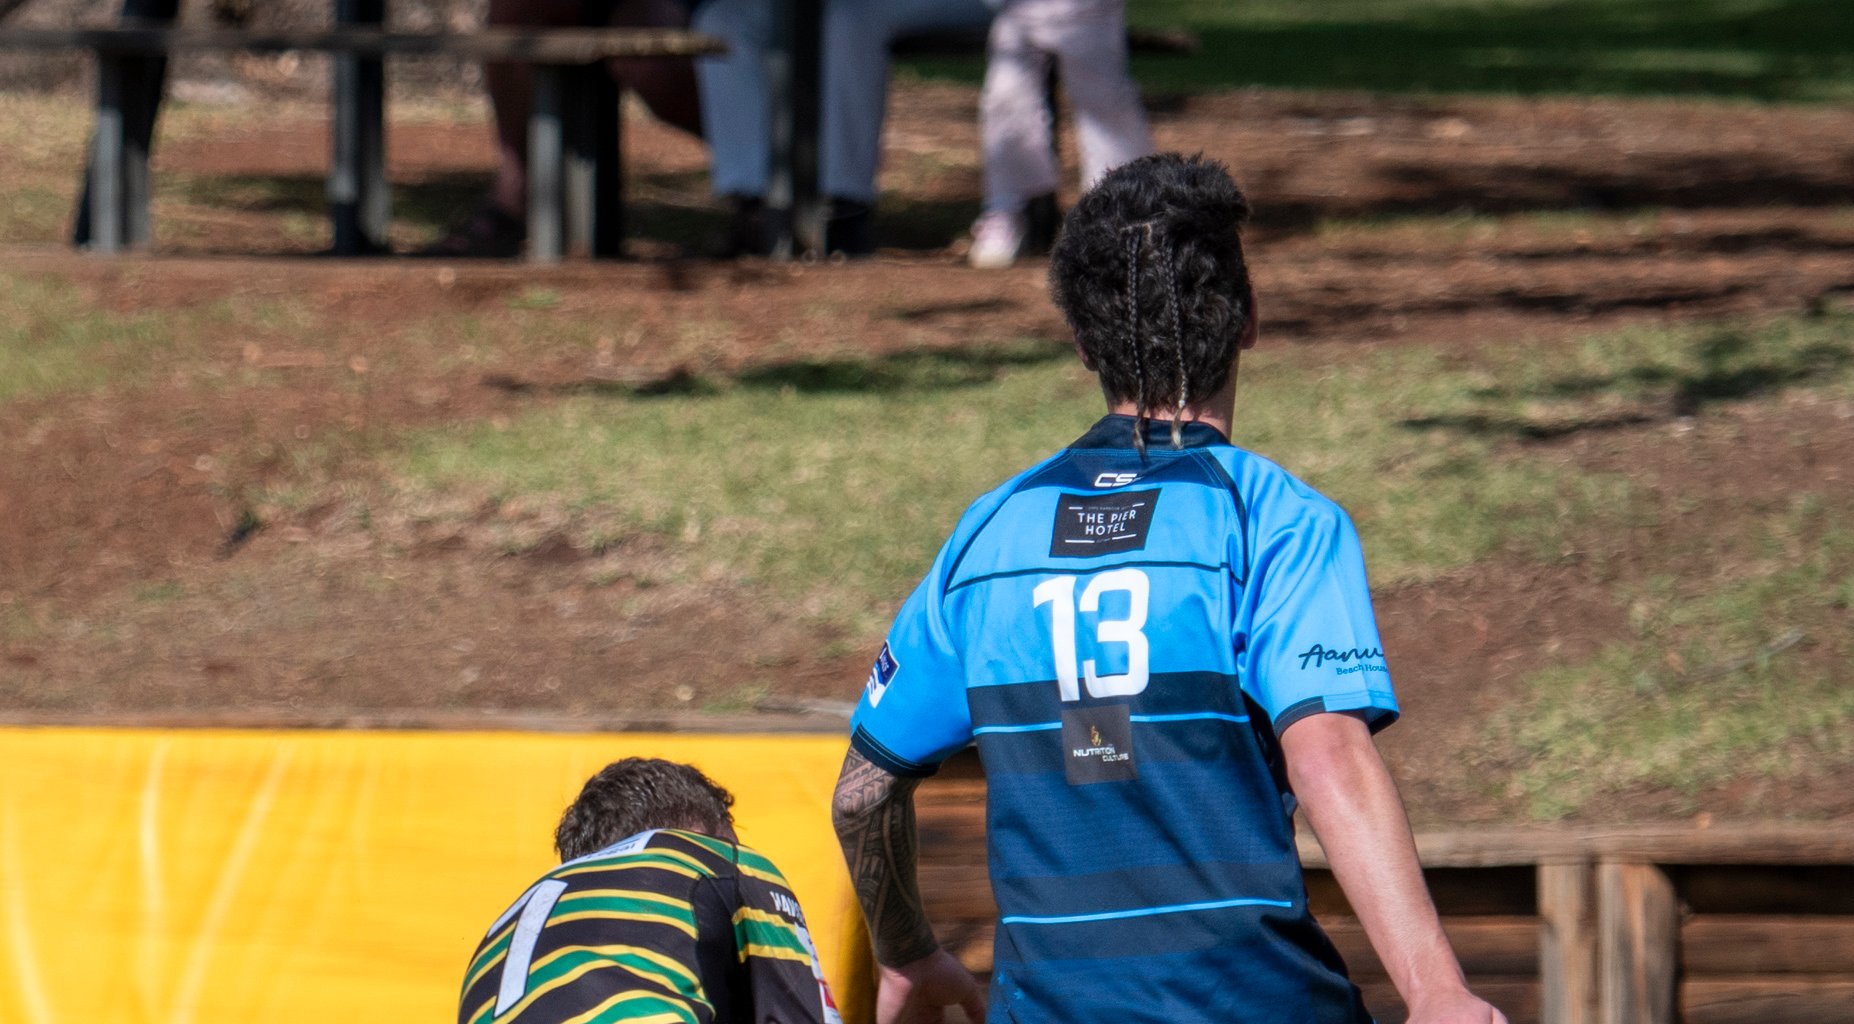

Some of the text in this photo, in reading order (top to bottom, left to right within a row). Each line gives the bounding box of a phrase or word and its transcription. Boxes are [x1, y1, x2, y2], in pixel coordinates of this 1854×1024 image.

[1077, 509, 1137, 524] THE PIER
[1085, 523, 1126, 536] HOTEL
[1033, 568, 1150, 702] 13
[1335, 663, 1365, 676] Beach
